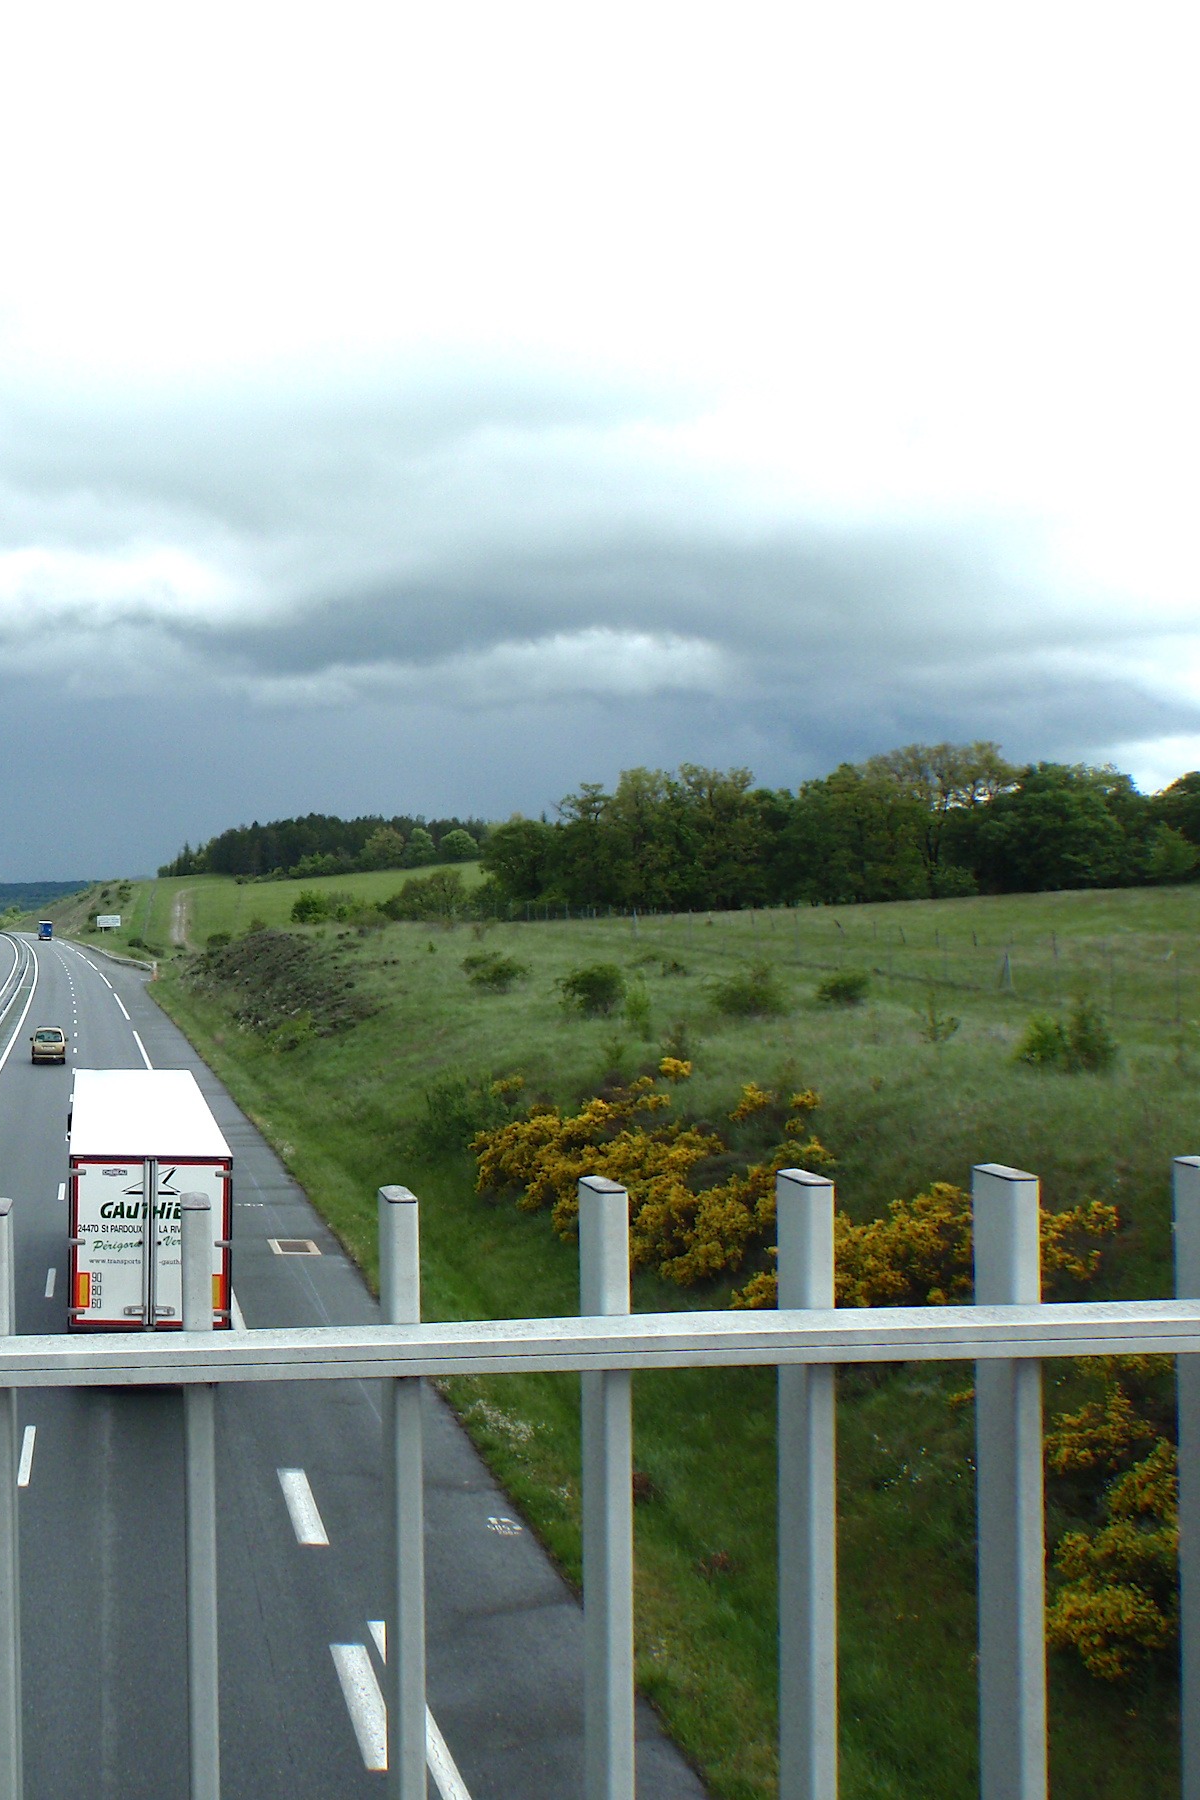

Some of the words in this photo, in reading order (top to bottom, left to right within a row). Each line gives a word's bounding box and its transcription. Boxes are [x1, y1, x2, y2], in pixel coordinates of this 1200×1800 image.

[78, 1224, 99, 1233] 24470
[110, 1224, 143, 1234] PARDOUX
[159, 1225, 168, 1234] LA
[170, 1225, 181, 1234] RIV
[163, 1236, 181, 1246] Ver
[91, 1272, 102, 1282] 90
[91, 1285, 102, 1295] 80
[91, 1298, 102, 1309] 60
